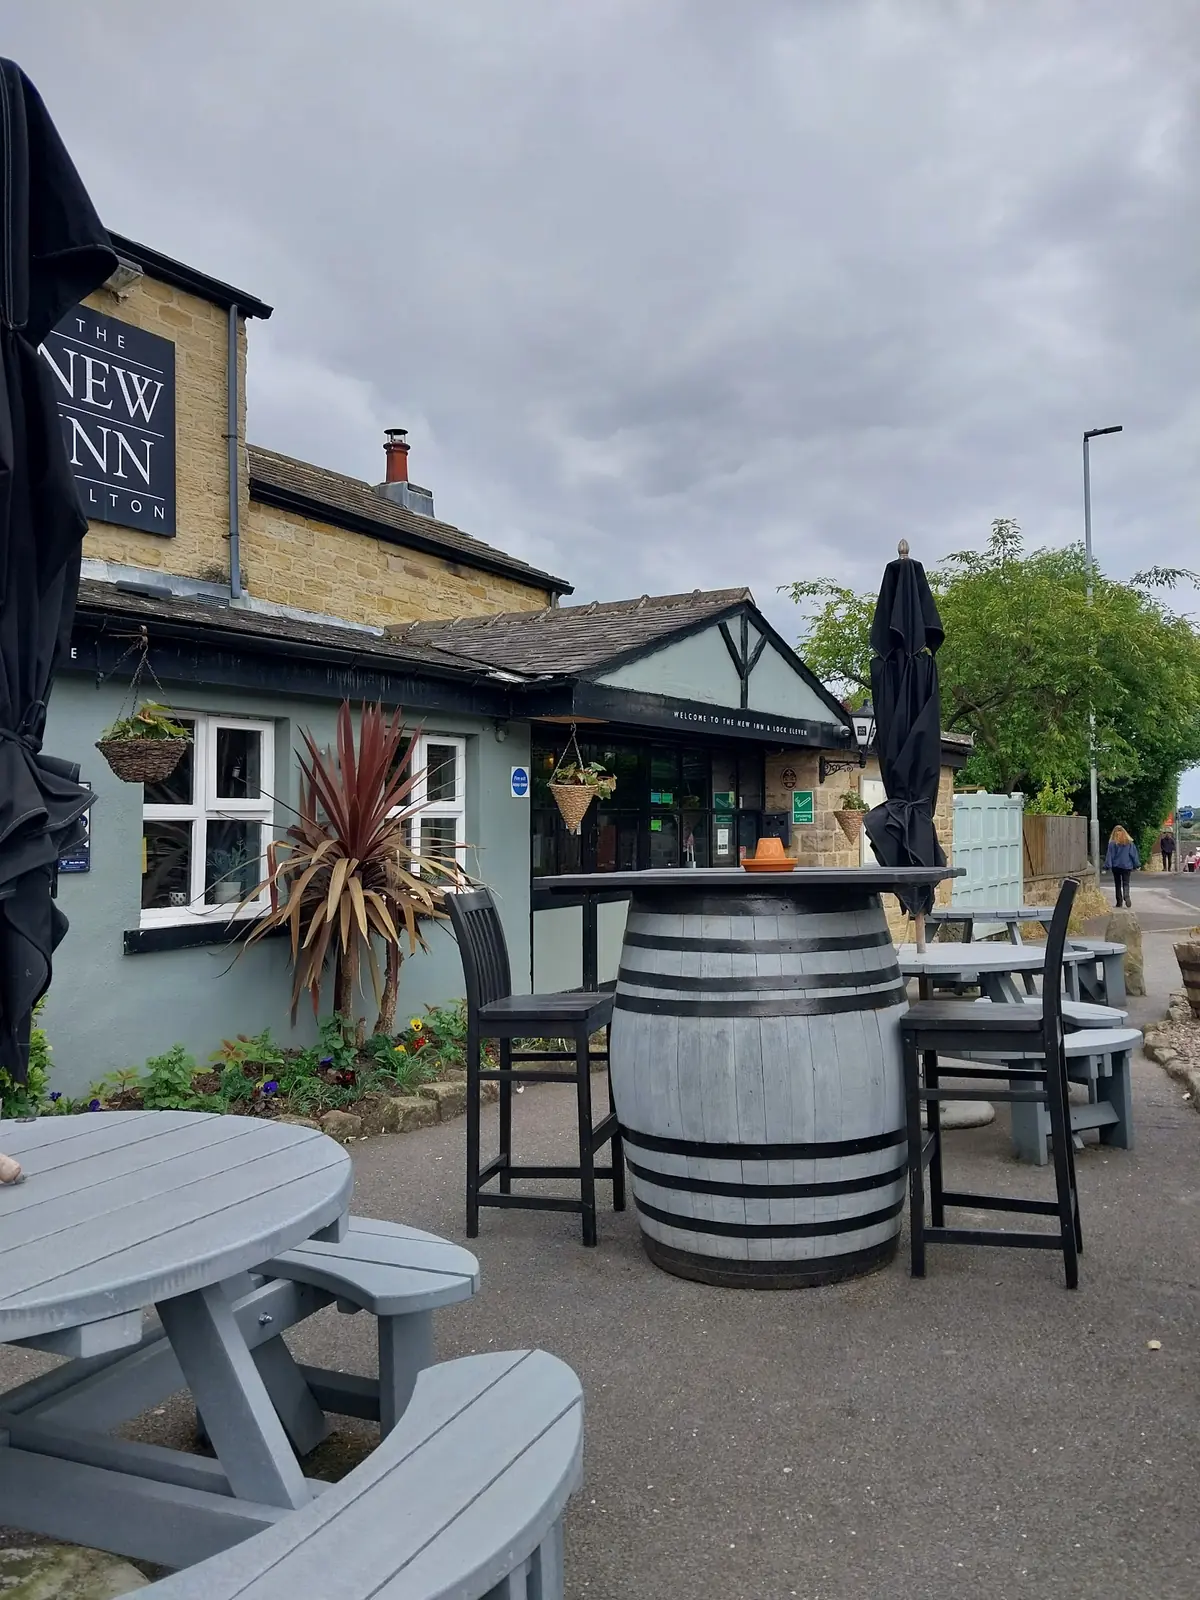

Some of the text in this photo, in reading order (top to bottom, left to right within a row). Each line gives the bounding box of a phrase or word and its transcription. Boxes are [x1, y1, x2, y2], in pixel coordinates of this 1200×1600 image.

[76, 318, 124, 348] THE
[37, 343, 164, 423] NEW
[59, 413, 154, 485] NN
[89, 489, 165, 519] LTON
[673, 711, 707, 723] WELCOME
[710, 716, 719, 724] TO
[722, 717, 734, 726] THE
[737, 720, 750, 728] NEW
[753, 722, 764, 731] INN
[789, 728, 808, 736] ELEVEN
